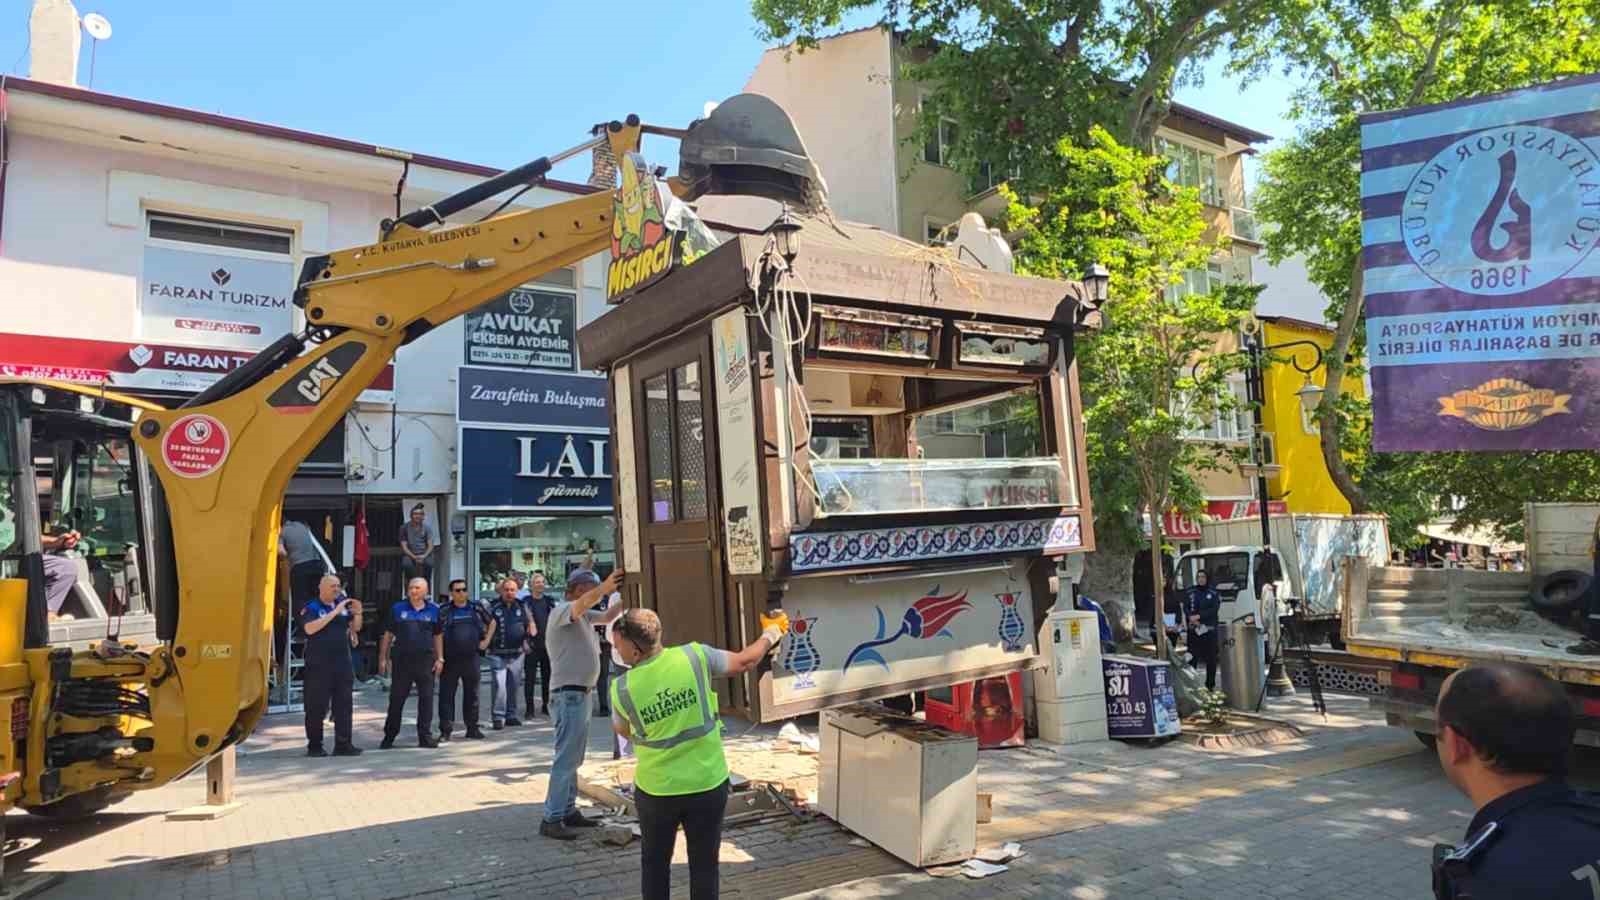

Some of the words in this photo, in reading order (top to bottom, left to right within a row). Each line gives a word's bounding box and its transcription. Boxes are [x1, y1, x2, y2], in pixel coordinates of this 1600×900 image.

[150, 283, 213, 300] FARAN
[219, 290, 287, 309] TURİZM
[480, 312, 562, 335] AVUKAT
[472, 331, 514, 346] EKREM
[517, 334, 569, 350] AYDEMİR
[163, 351, 228, 370] FARAN
[297, 357, 341, 402] CAT
[470, 384, 540, 406] Zarafetin
[543, 390, 606, 409] Buluşma
[1121, 702, 1133, 714] 10
[1134, 701, 1146, 714] 43
